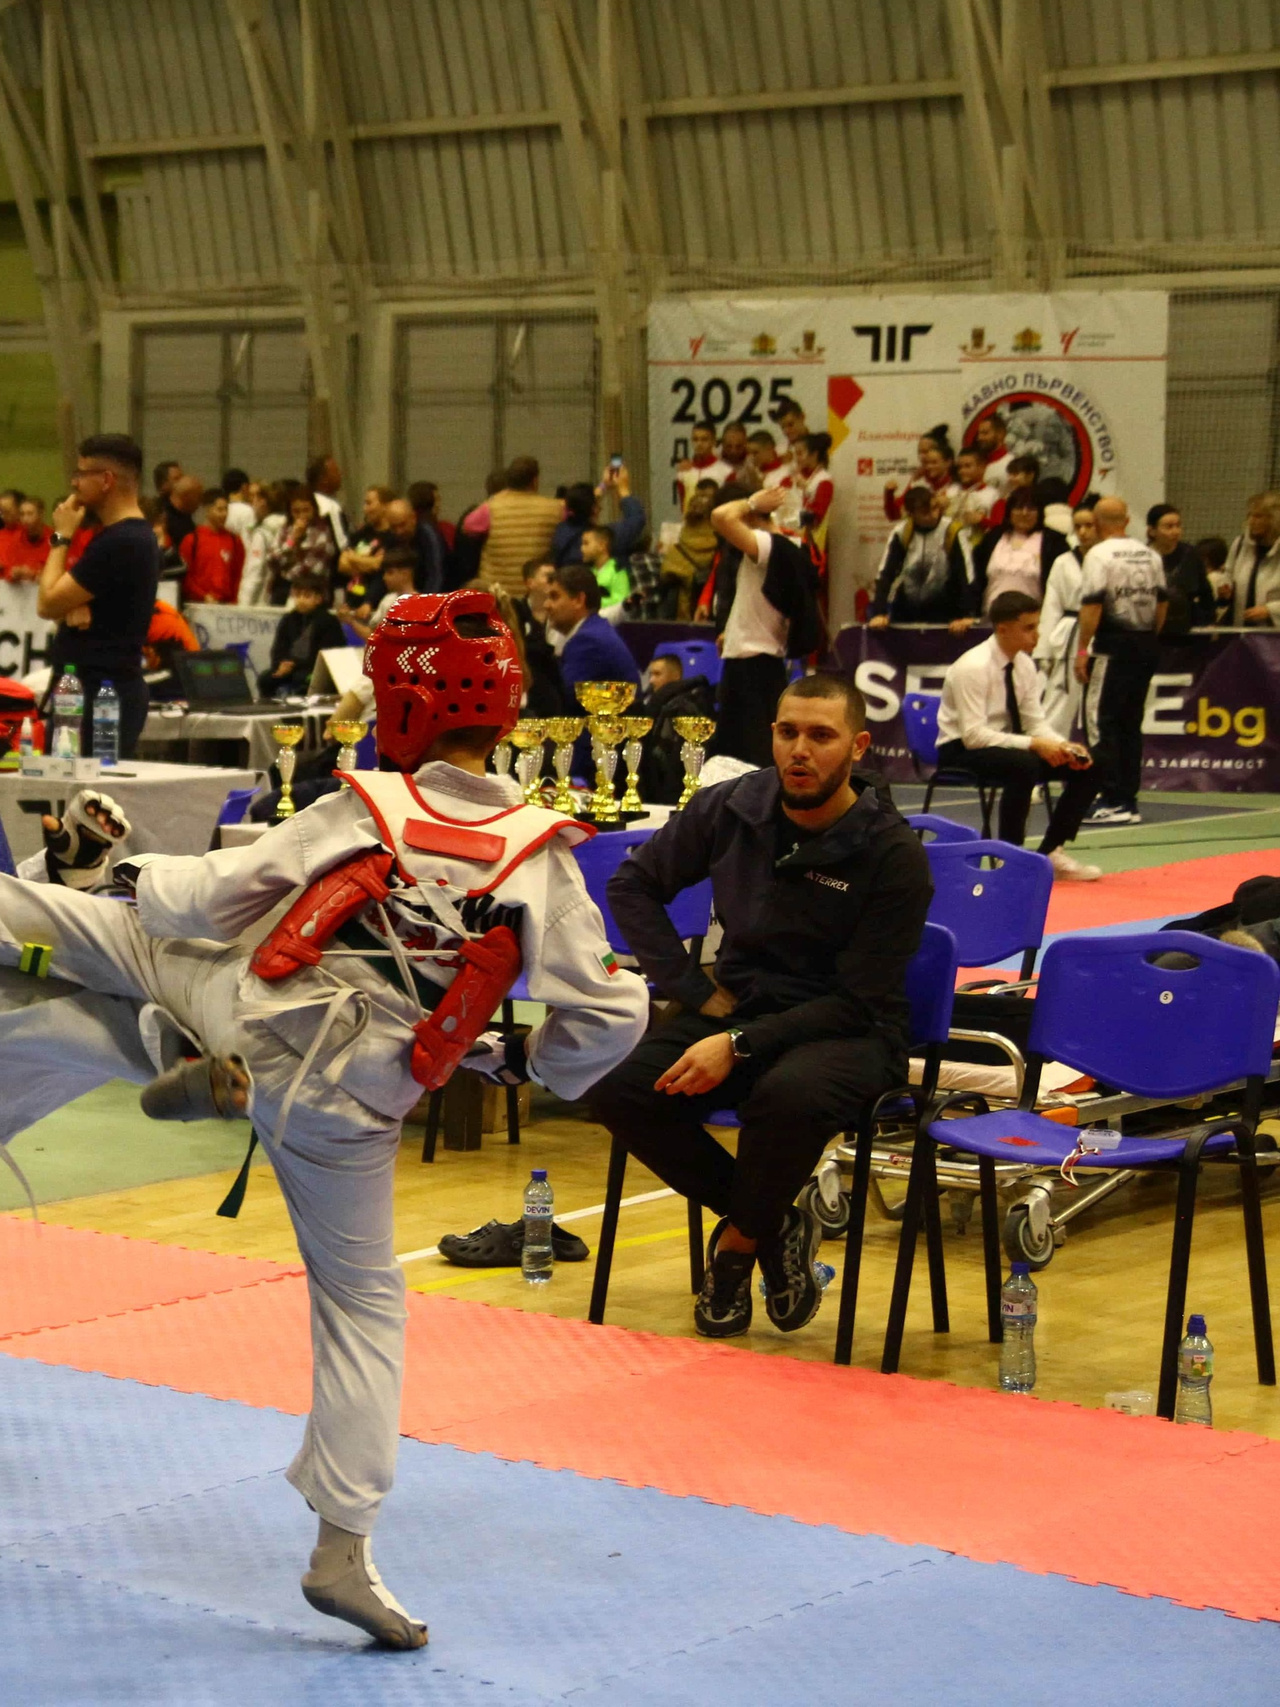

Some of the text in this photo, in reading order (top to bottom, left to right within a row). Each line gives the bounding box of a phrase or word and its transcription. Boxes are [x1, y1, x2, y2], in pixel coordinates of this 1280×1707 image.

[671, 377, 794, 424] 2025
[962, 372, 1115, 463] ЖАВНО ПЪРВЕНСТВО
[1159, 758, 1264, 769] ЗАВИСИМОСТ
[815, 872, 849, 892] TERREX
[526, 1205, 551, 1214] DEVIN
